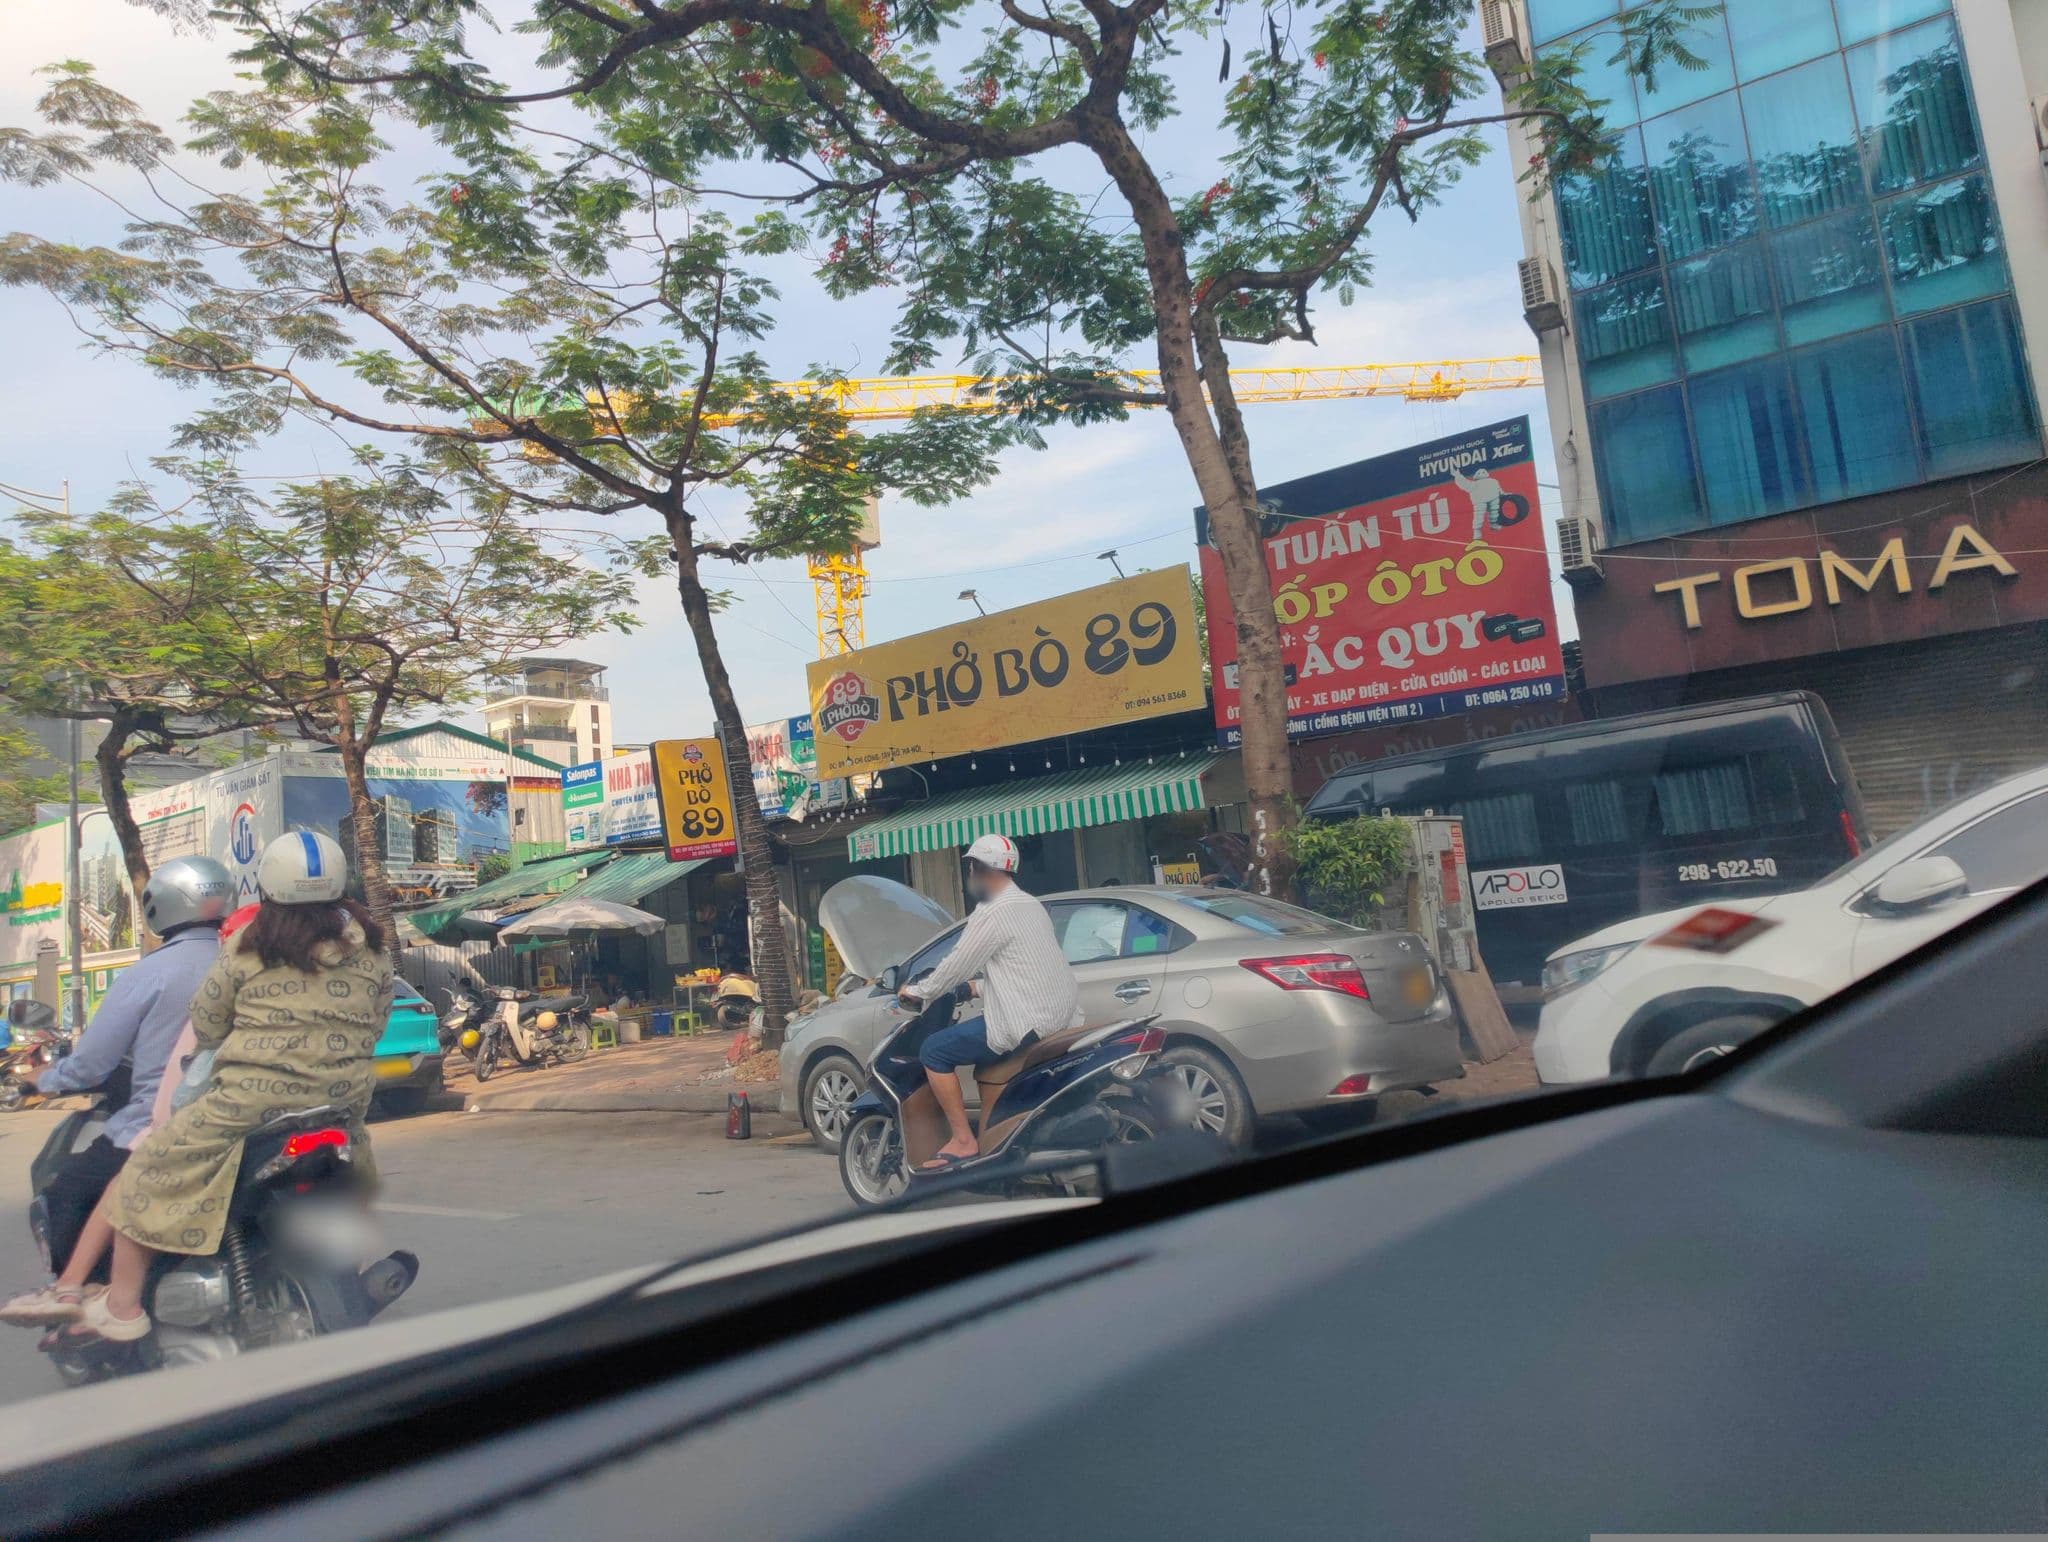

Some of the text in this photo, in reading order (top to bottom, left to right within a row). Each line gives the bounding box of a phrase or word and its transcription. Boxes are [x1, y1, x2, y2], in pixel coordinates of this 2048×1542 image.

[1419, 448, 1488, 478] HYUNDAI
[1268, 491, 1450, 571] TUẤN TÚ
[1273, 539, 1504, 625] ỐP ÔTÔ
[1654, 524, 2019, 629] TOMA
[1299, 625, 1364, 679] ẮC
[1377, 609, 1487, 670] QUY
[885, 601, 1177, 723] PHỞ BÒ 89
[832, 679, 861, 705] 89
[1312, 692, 1328, 707] XE
[1331, 689, 1354, 705] ĐẠP
[1359, 681, 1389, 700] ĐIỆN
[1400, 672, 1427, 692] CỬA
[1430, 666, 1468, 688] CUỐN
[1481, 660, 1510, 679] CÁC
[1513, 656, 1546, 674] LOẠI
[1136, 698, 1150, 707] 094
[1152, 694, 1165, 704] 563
[1168, 690, 1187, 701] 8368
[1341, 711, 1366, 729] BỆNH
[1367, 704, 1389, 723] VIỆN
[1391, 704, 1409, 717] TIM
[1465, 694, 1480, 707] ĐT:
[1482, 690, 1508, 705] 0964
[1510, 686, 1529, 700] 250
[1532, 683, 1552, 696] 419
[383, 766, 394, 777] TIM
[566, 767, 597, 783] Salonpas
[608, 763, 632, 792] NHÀ
[678, 762, 713, 786] PHỞ
[686, 785, 711, 806] BÒ
[682, 807, 724, 839] 89
[1480, 893, 1566, 907] APOLLO SEIKO
